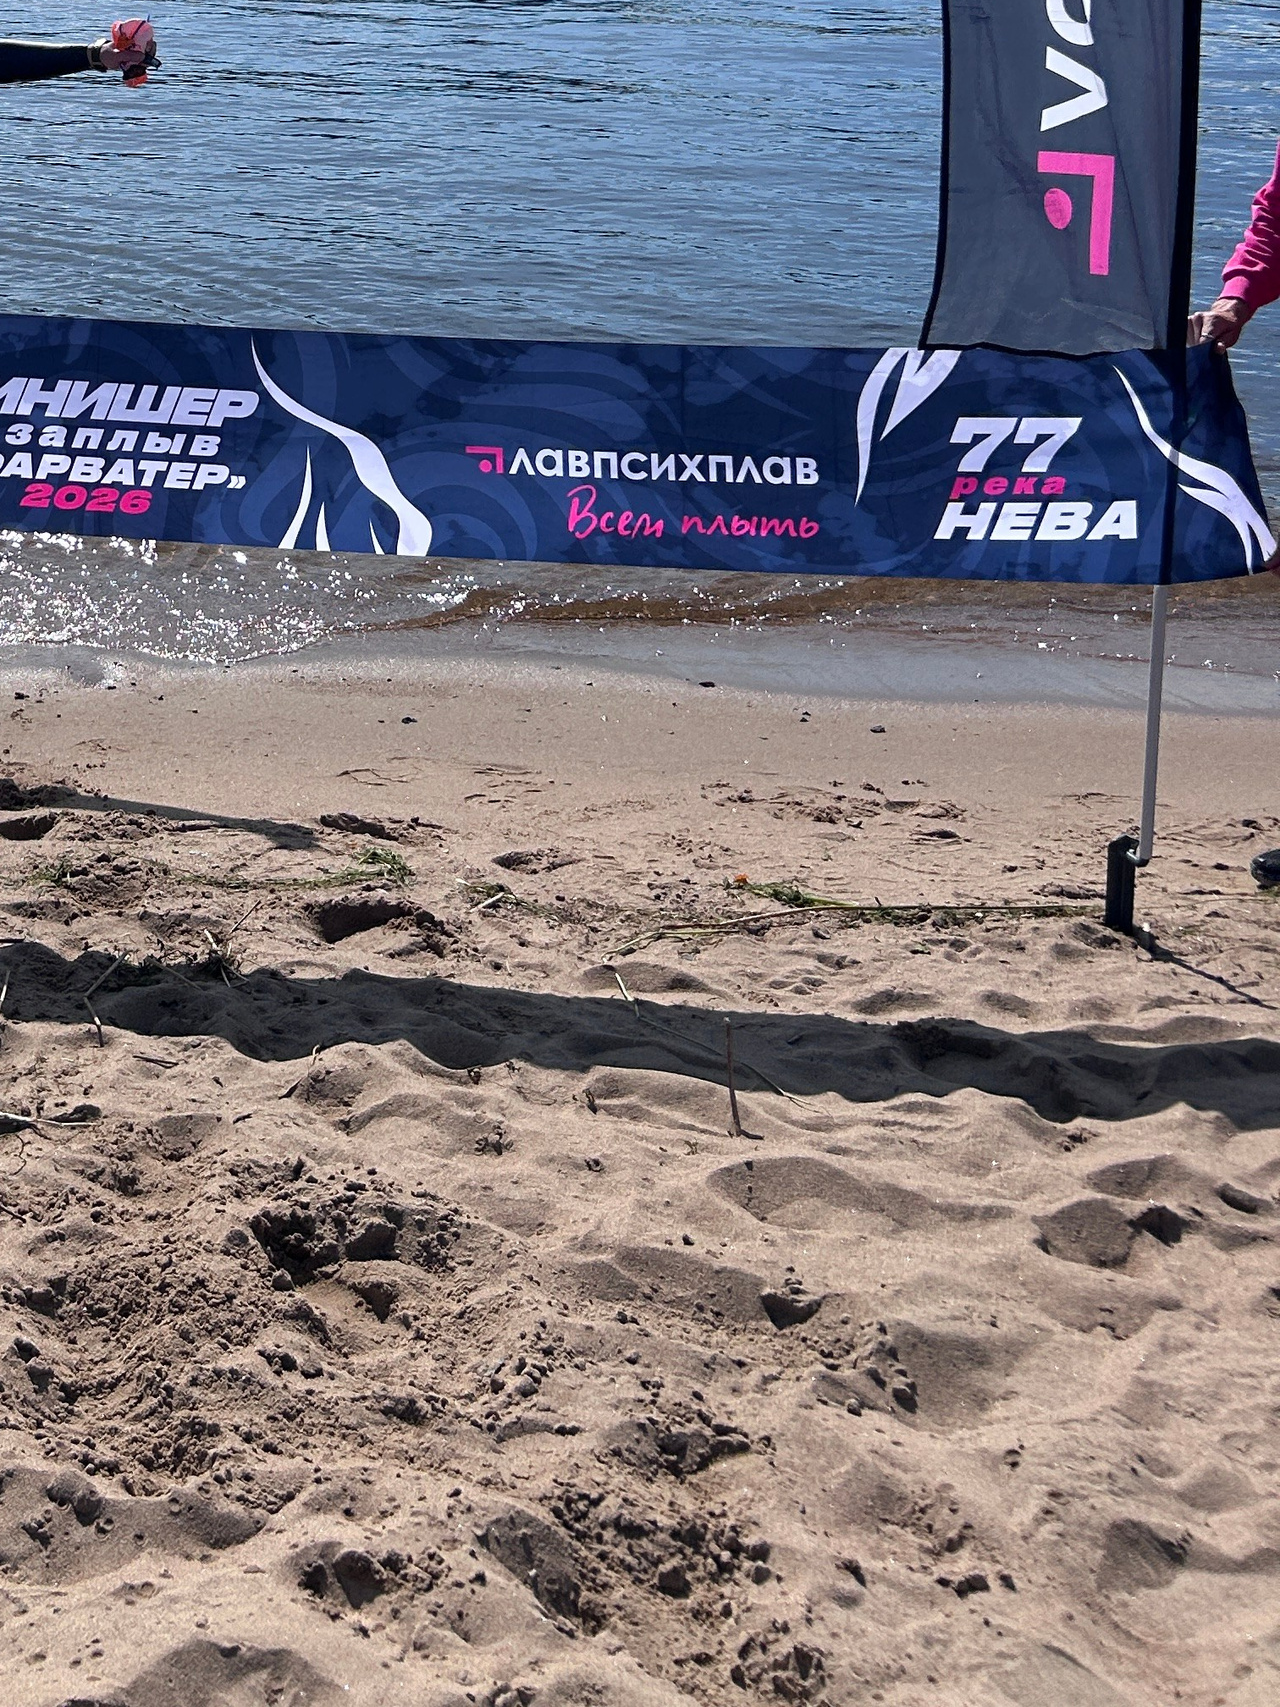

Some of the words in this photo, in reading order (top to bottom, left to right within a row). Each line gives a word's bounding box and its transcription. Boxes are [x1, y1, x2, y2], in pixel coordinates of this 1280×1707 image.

[5, 423, 221, 458] заплыв
[949, 417, 1083, 473] 77
[19, 482, 153, 515] 2026
[950, 476, 1067, 500] река
[566, 484, 664, 540] Всем
[680, 514, 820, 540] плыть
[933, 500, 1139, 542] НЕВА
